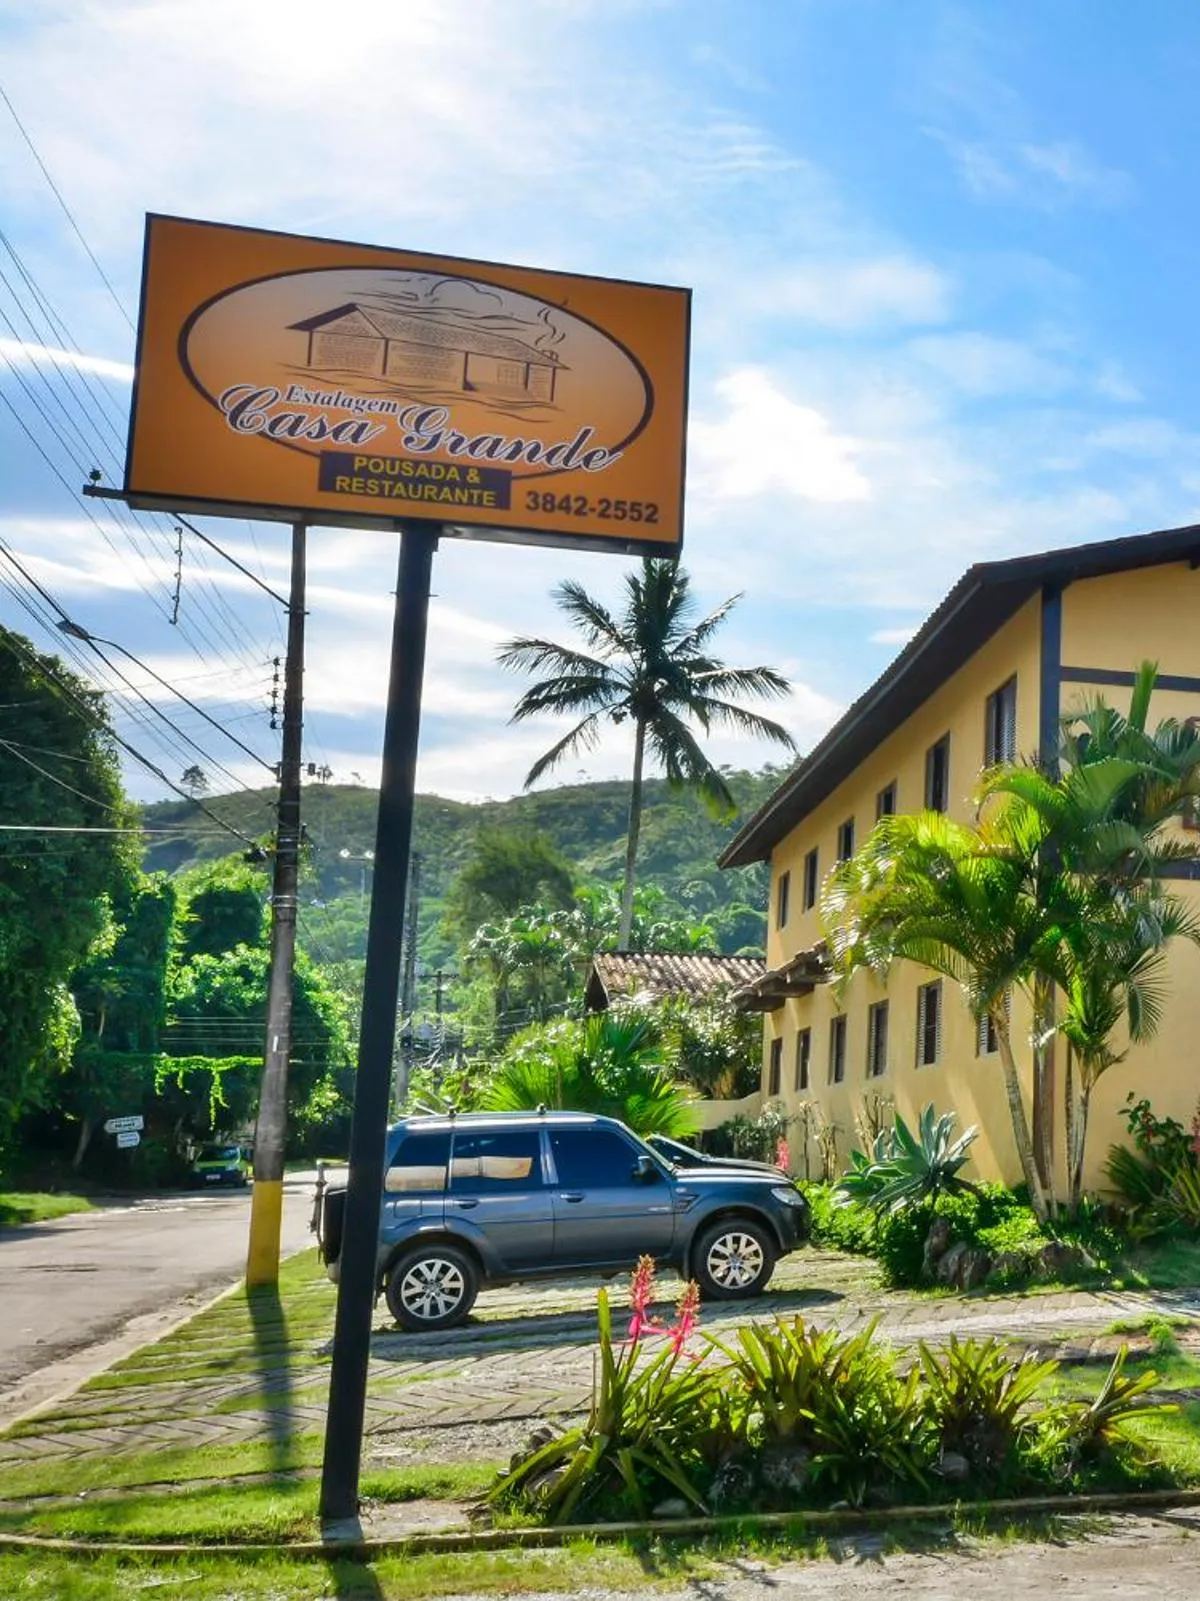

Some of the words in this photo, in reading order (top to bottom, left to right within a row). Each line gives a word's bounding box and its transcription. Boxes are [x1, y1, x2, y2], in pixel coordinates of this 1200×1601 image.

[285, 384, 399, 415] Estalagem
[219, 384, 387, 445] Casa
[398, 404, 623, 473] Grande
[353, 456, 461, 482] POUSADA
[466, 467, 481, 484] &
[335, 475, 497, 507] RESTAURANTE
[525, 489, 660, 524] 3842-2552
